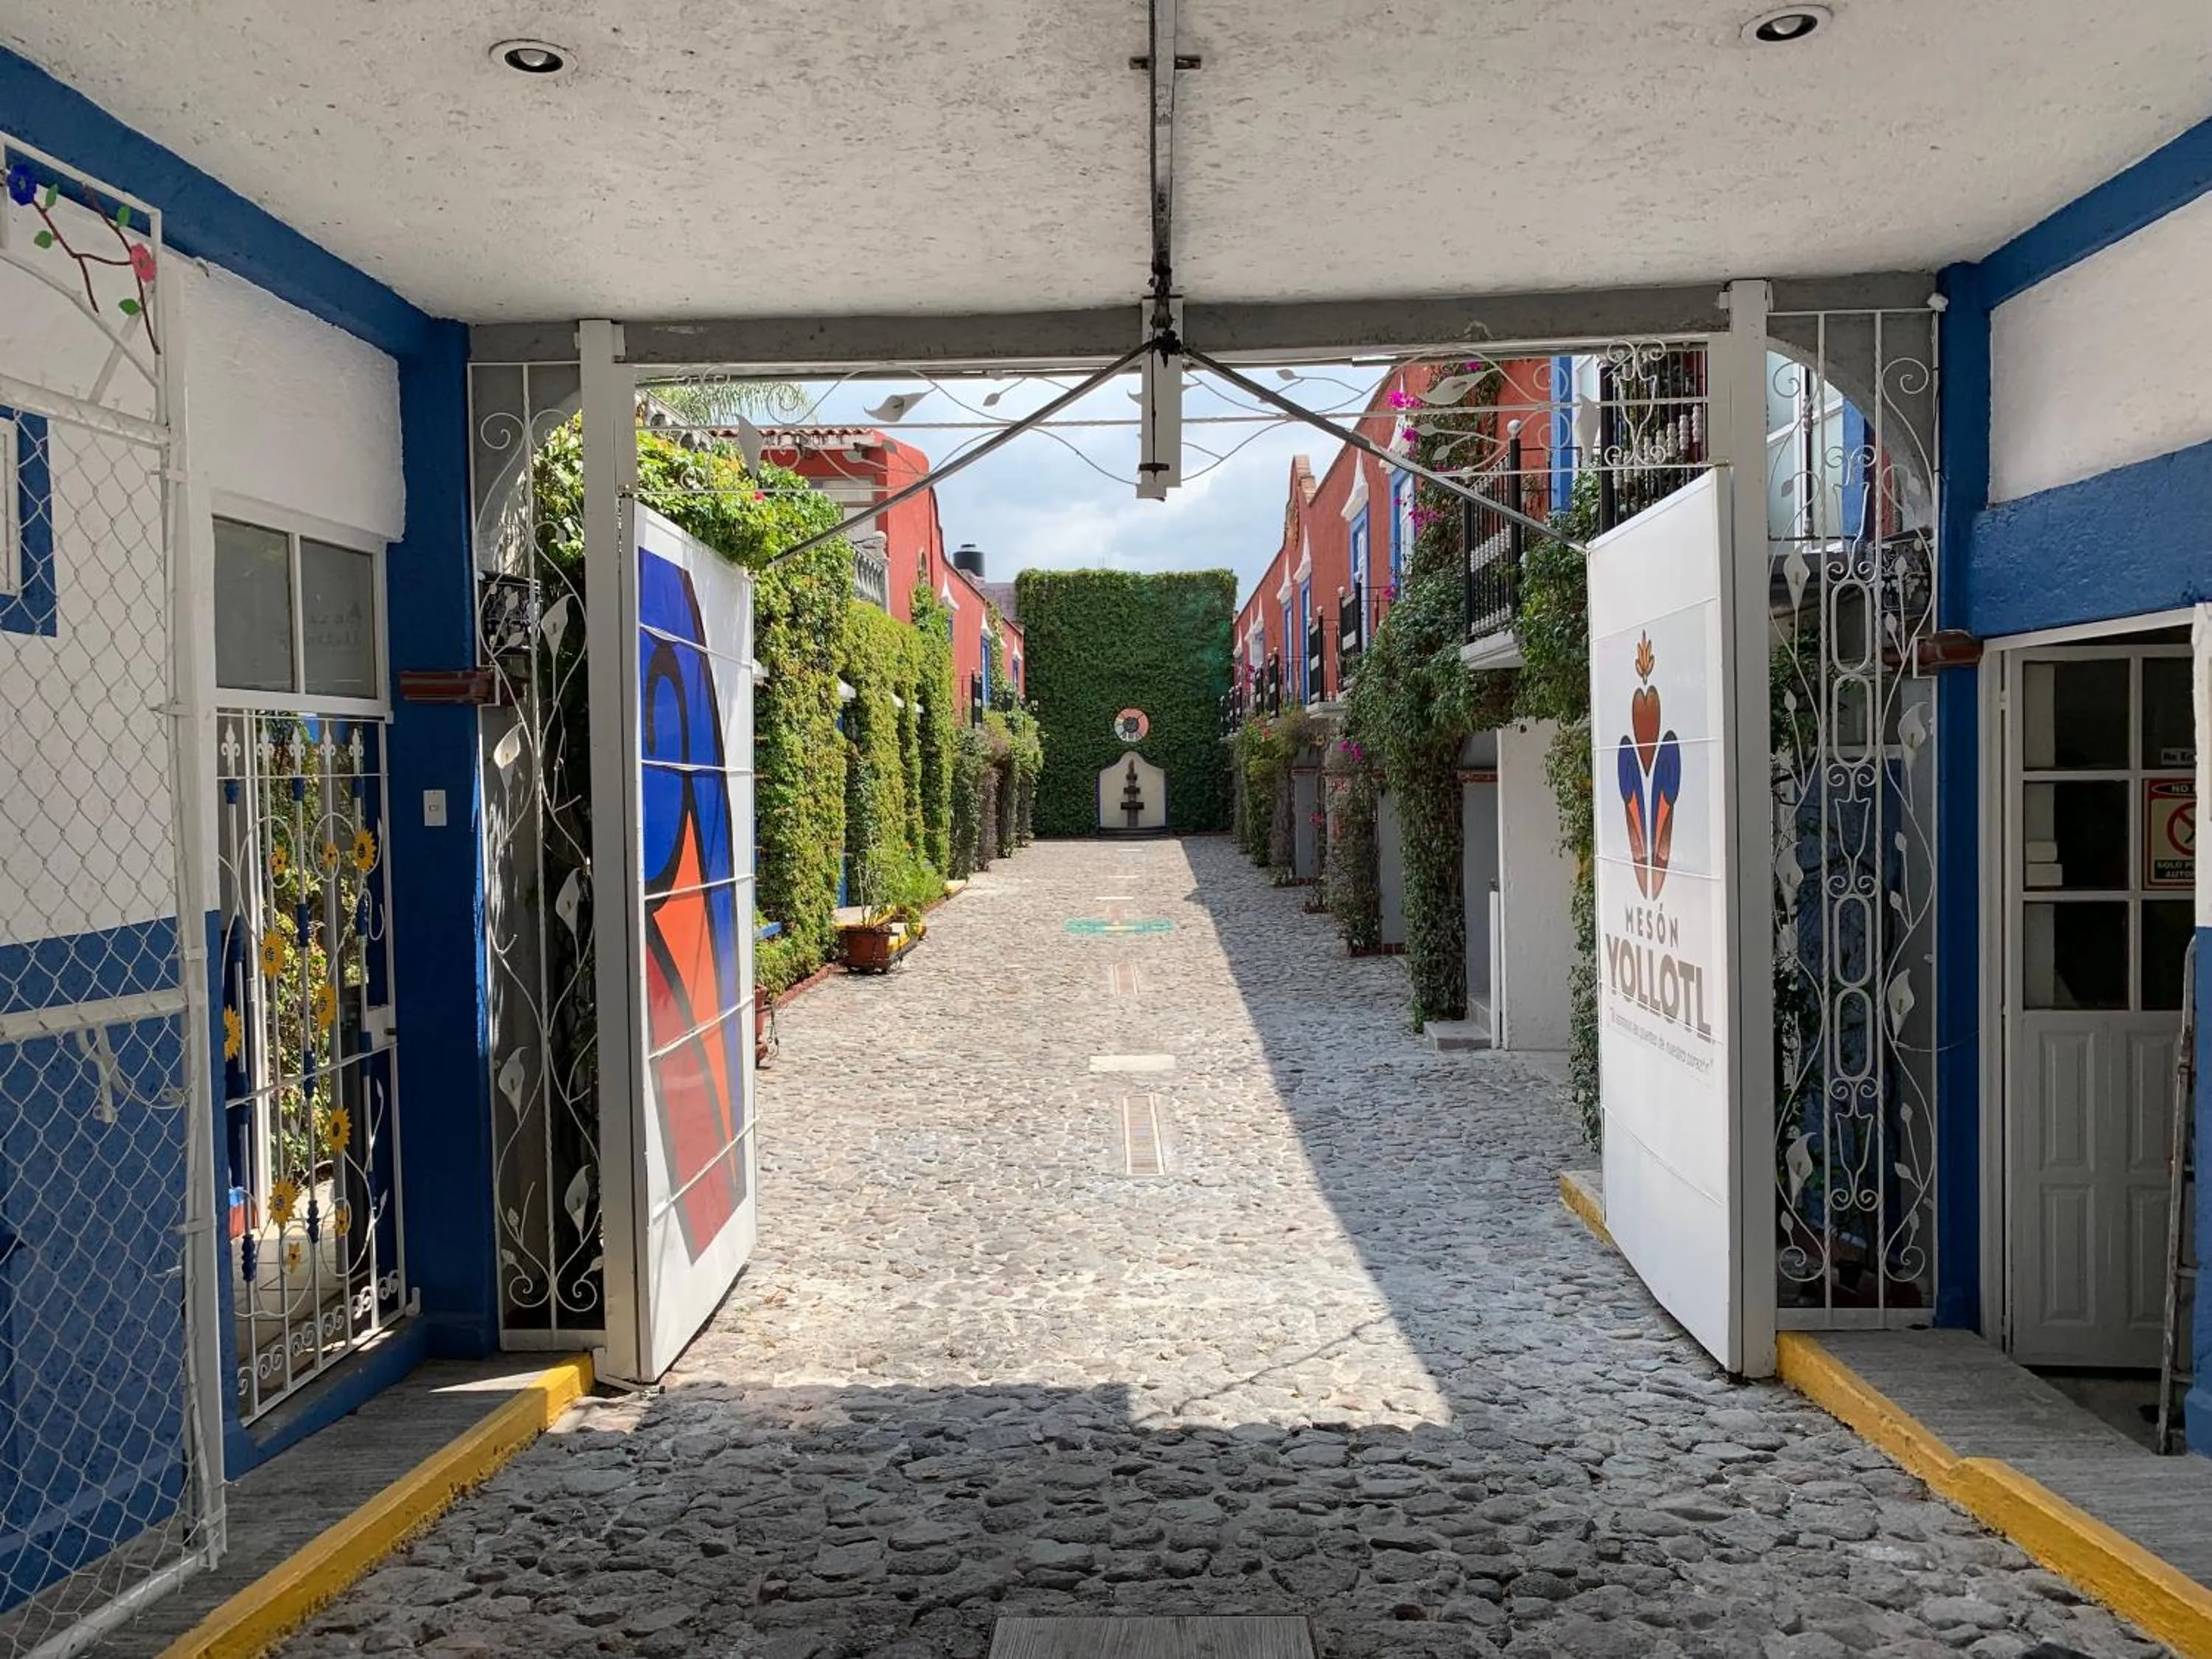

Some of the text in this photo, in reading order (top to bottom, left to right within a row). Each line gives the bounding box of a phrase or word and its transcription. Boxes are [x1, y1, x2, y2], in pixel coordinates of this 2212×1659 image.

[2171, 784, 2189, 793] NO
[1625, 902, 1679, 949] MESÓN
[1605, 933, 1711, 1044] YOLLOTL
